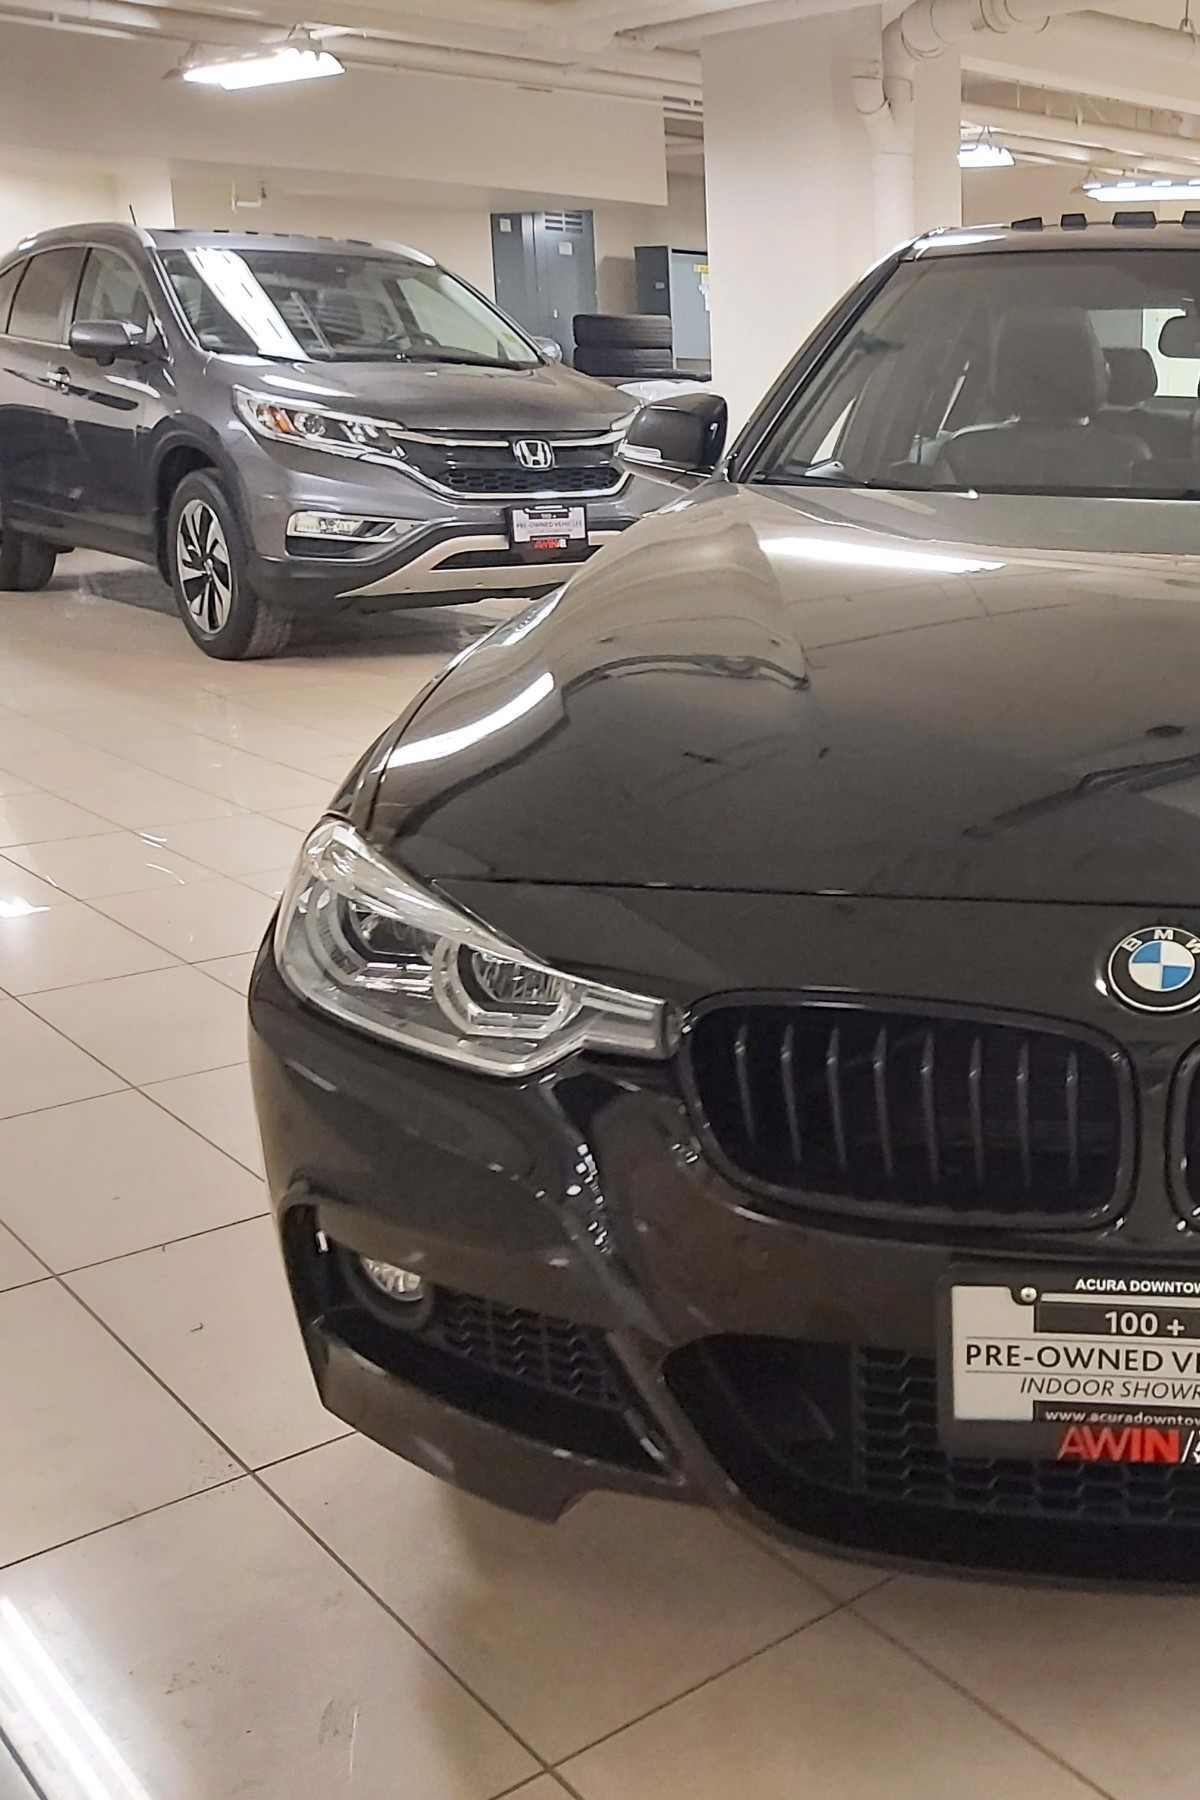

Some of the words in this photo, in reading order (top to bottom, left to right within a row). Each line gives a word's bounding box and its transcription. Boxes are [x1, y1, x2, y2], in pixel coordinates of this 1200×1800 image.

[1075, 1278, 1127, 1292] ACURA
[1104, 1310, 1158, 1336] 100
[966, 1343, 1163, 1372] PRE-OWNED
[1020, 1376, 1114, 1397] INDOOR
[1057, 1424, 1181, 1464] AWIN
